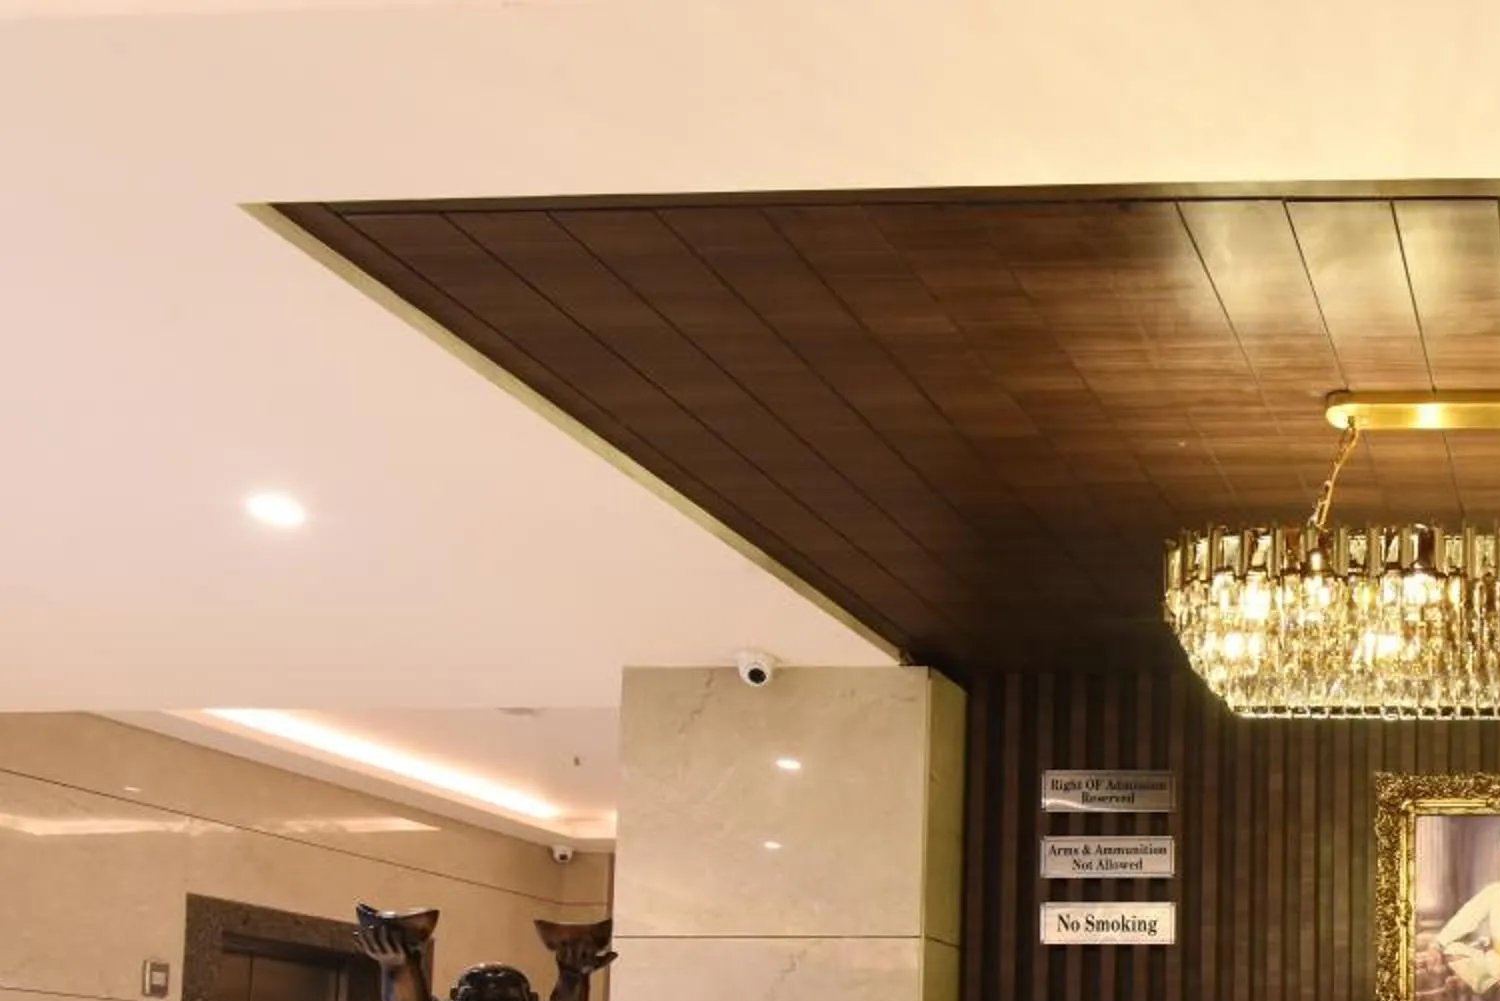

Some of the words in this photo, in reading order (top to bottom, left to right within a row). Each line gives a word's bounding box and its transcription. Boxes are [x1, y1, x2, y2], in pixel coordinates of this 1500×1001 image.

[1051, 778, 1082, 792] Right
[1049, 843, 1079, 856] Arms
[1081, 844, 1093, 856] &
[1096, 843, 1167, 856] Ammunition
[1072, 859, 1093, 871] Not
[1096, 858, 1144, 871] Allowed
[1057, 913, 1080, 932] No
[1084, 913, 1158, 935] Smoking
